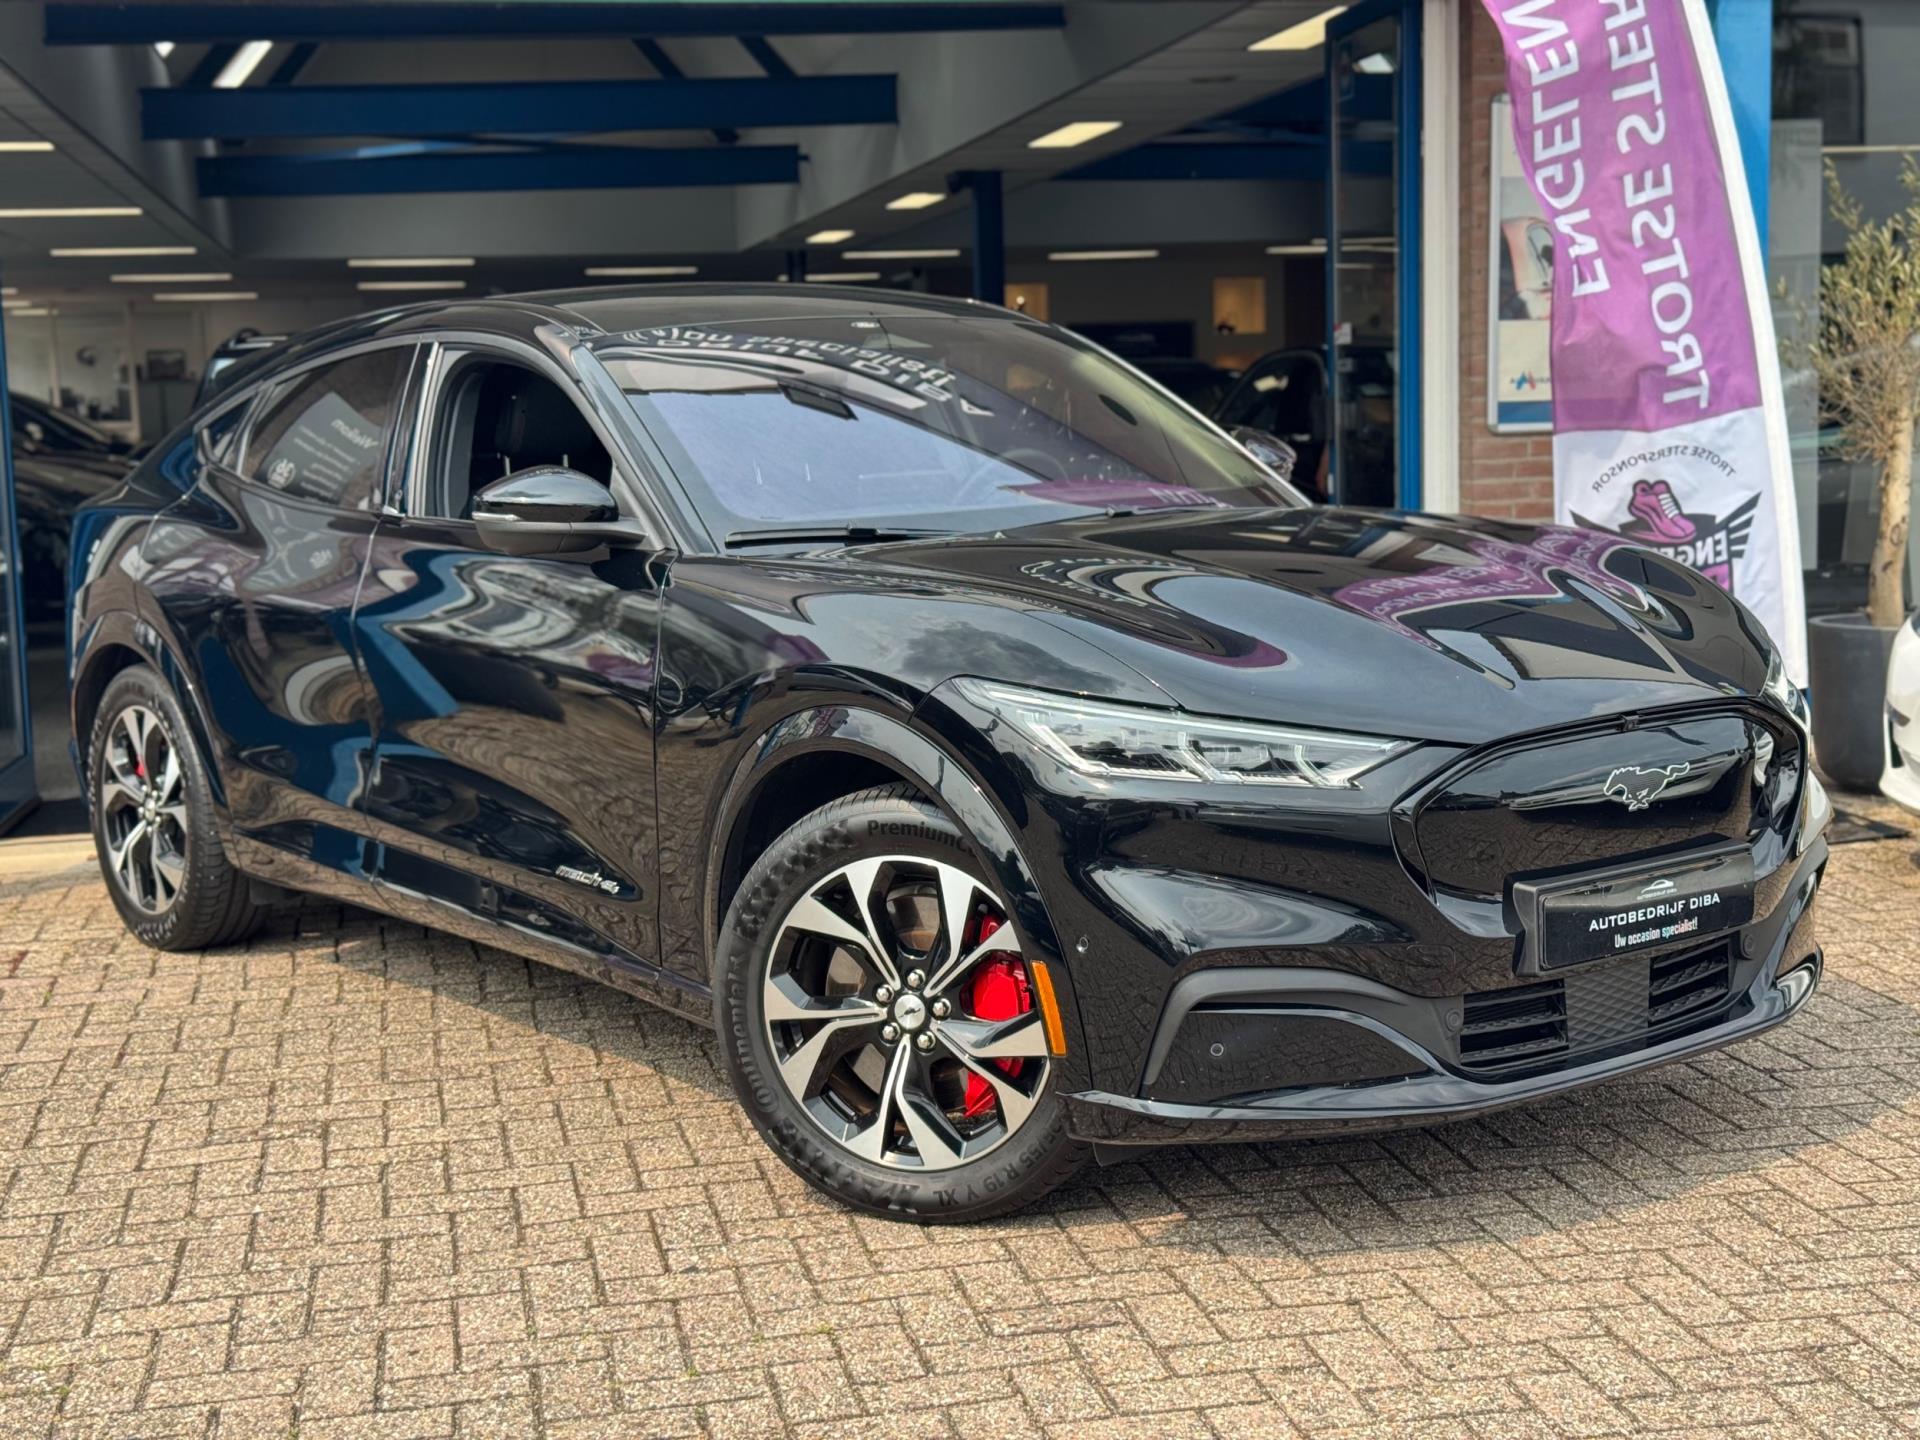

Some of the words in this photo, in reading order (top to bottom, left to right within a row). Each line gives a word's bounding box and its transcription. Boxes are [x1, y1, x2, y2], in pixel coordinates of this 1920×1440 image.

[1588, 899, 1687, 933] AUTOBEDRIJF
[1689, 891, 1721, 911] DIBA
[1614, 933, 1627, 949] Uw
[1627, 926, 1661, 946] occasion
[1661, 916, 1699, 939] specialist!
